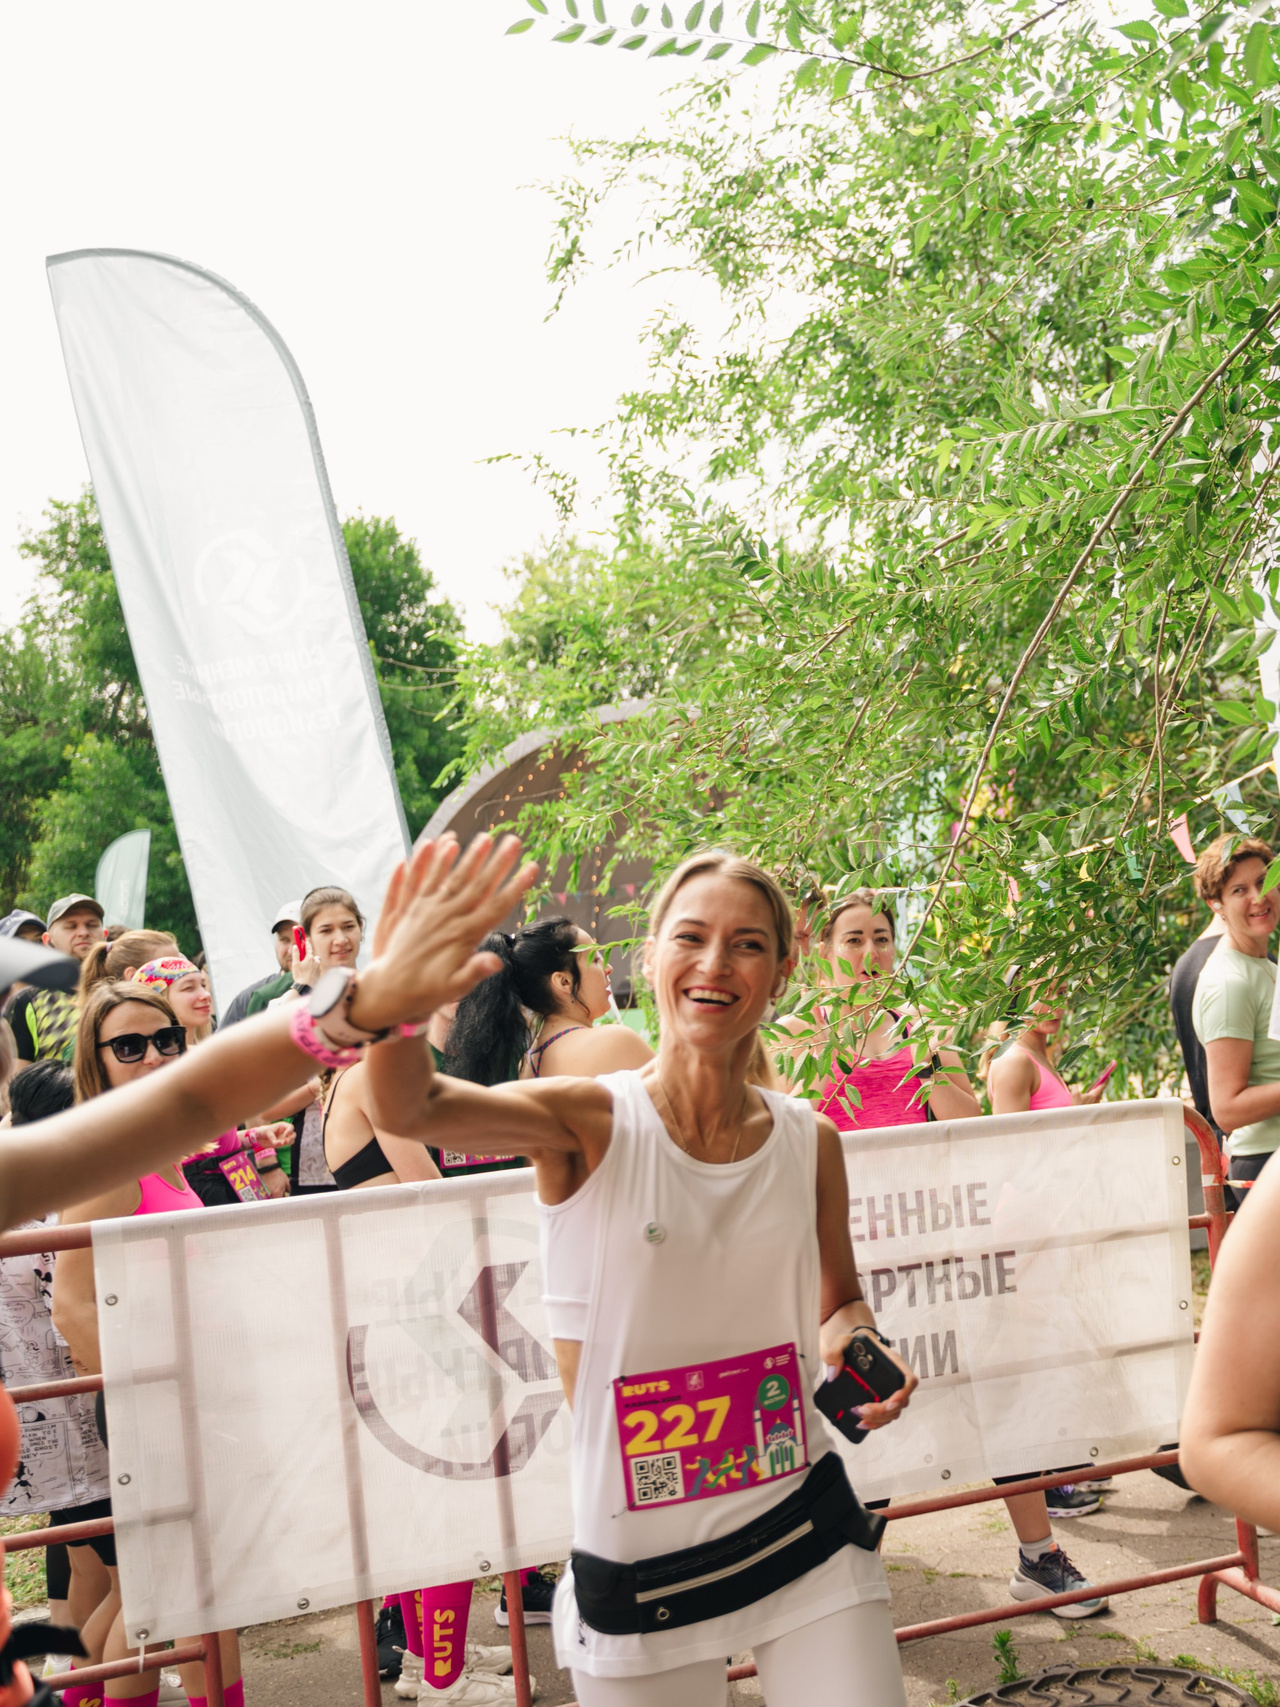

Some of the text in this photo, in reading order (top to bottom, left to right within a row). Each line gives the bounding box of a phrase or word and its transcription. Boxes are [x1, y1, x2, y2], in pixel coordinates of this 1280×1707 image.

[229, 1165, 256, 1191] 214
[890, 1330, 959, 1379] ИИ
[622, 1380, 670, 1398] RUTS
[766, 1380, 781, 1397] 2
[623, 1395, 732, 1455] 227
[433, 1609, 455, 1677] RUTS
